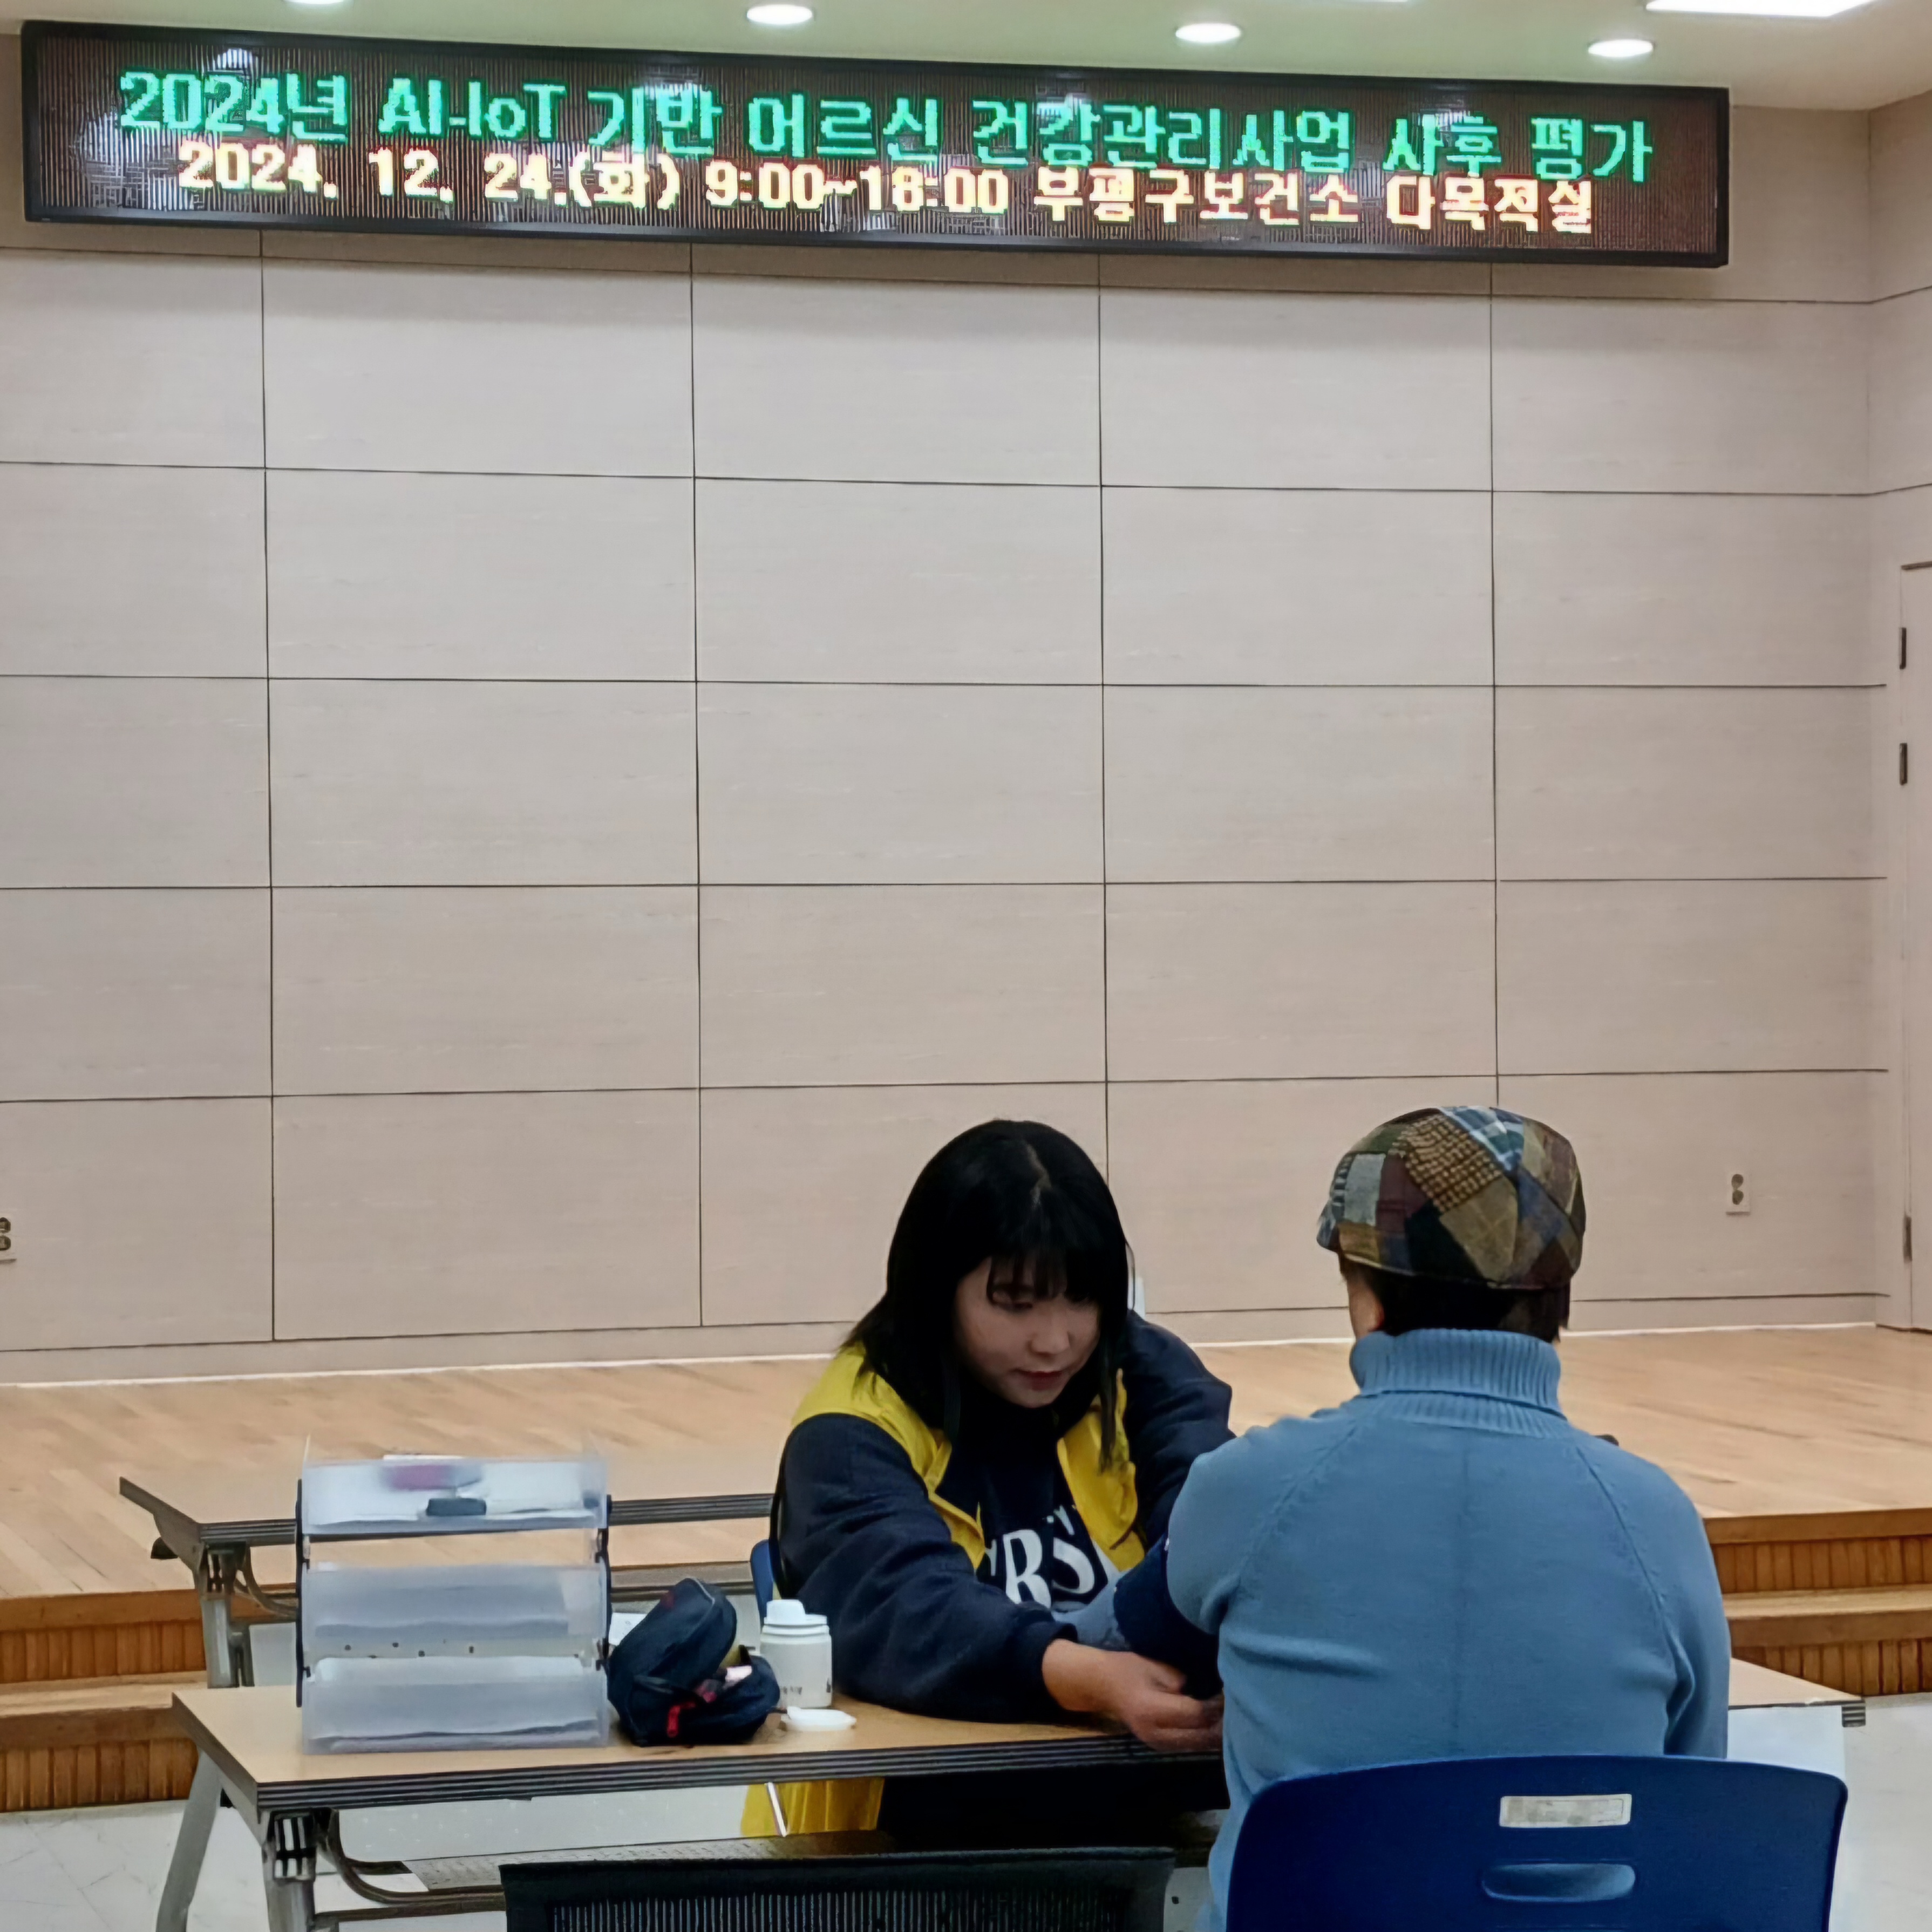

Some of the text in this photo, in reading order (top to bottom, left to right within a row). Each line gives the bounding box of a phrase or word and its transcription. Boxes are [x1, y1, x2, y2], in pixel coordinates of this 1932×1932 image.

[120, 71, 1653, 182] 2024년 AI-IoT 기반 어르신 건강관리사업 사후 평가
[179, 141, 338, 198] 2024.
[369, 147, 453, 203] 12.
[705, 160, 1008, 214] 9:00~18:00
[1033, 166, 1359, 225] 부평구보건소
[1386, 175, 1591, 234] 다목적실
[984, 1505, 1096, 1608] RS
